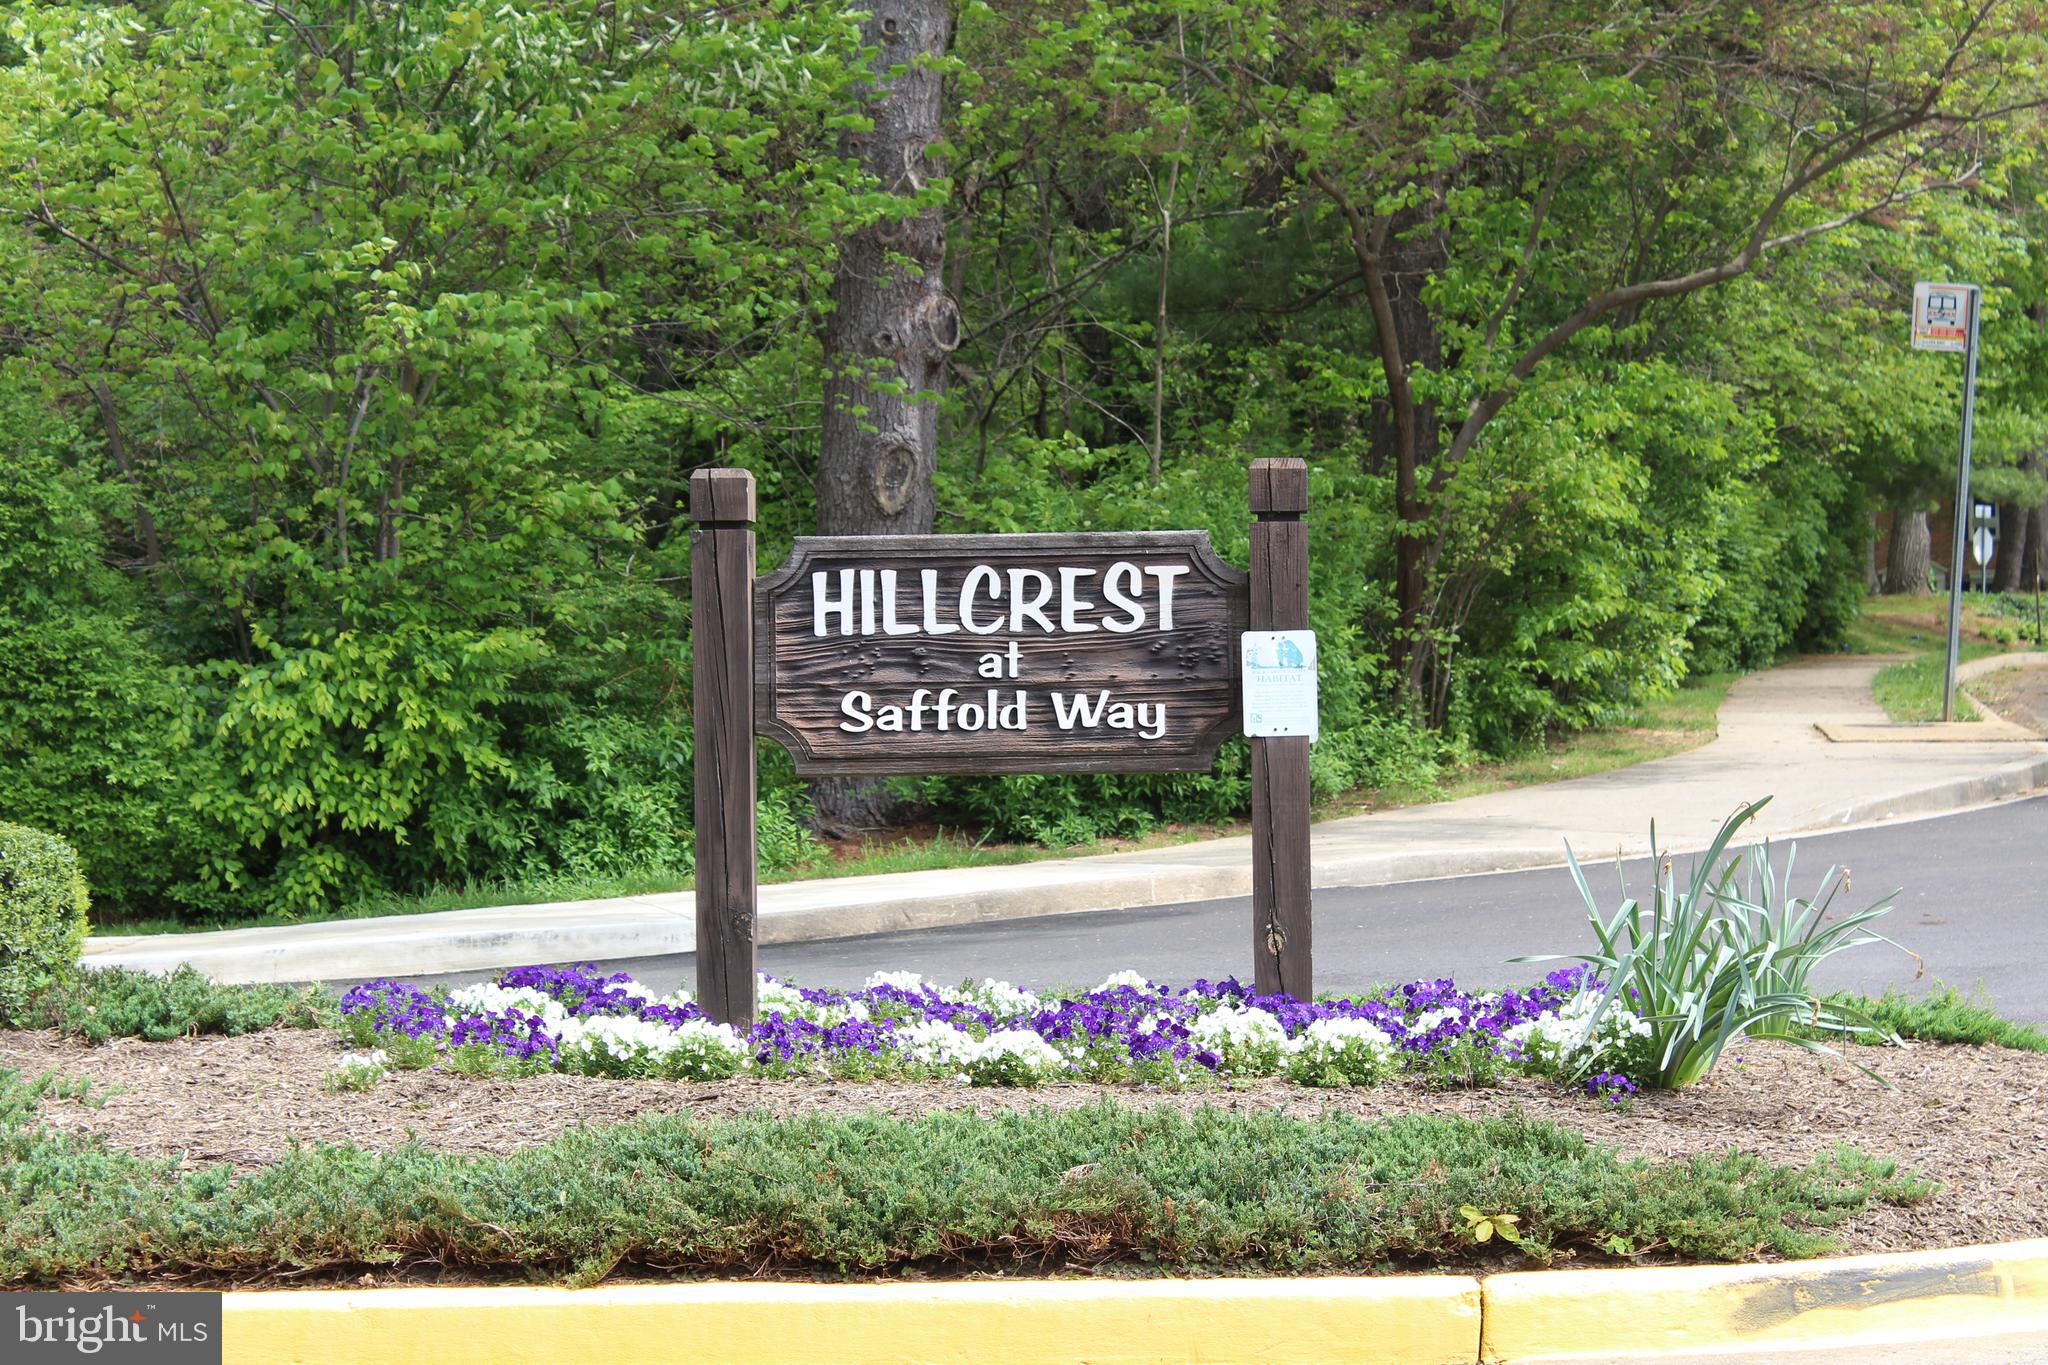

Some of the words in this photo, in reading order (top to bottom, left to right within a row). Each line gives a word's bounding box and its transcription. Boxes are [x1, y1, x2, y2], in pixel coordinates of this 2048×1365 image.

[812, 561, 1190, 637] HILLCREST
[978, 641, 1023, 679] at
[1256, 674, 1304, 683] HABITAT
[839, 688, 1027, 733] Saffold
[1051, 689, 1166, 740] Way
